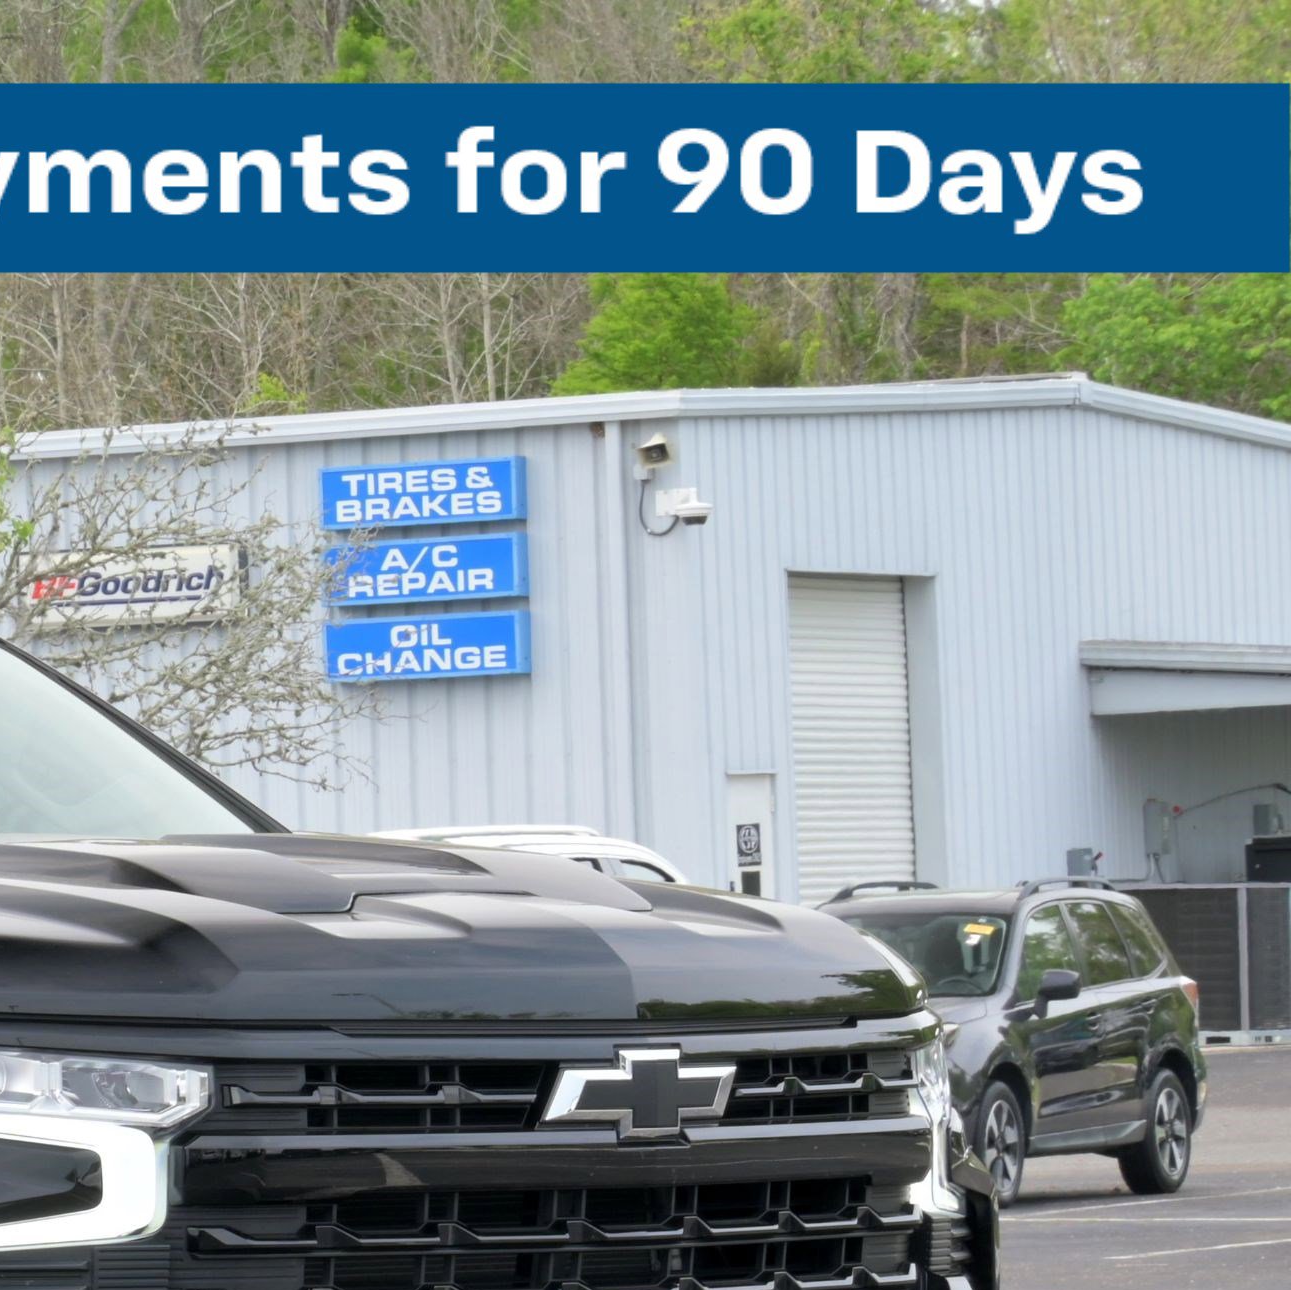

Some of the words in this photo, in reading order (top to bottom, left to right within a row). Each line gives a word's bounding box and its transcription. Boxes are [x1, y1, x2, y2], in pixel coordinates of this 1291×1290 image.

[341, 468, 457, 497] TIRES
[466, 466, 494, 489] &
[336, 491, 502, 523] BRAKES
[380, 544, 459, 575] A/C
[348, 567, 494, 598] REPAIR
[390, 623, 452, 648] OIL
[337, 645, 507, 676] CHANGE
